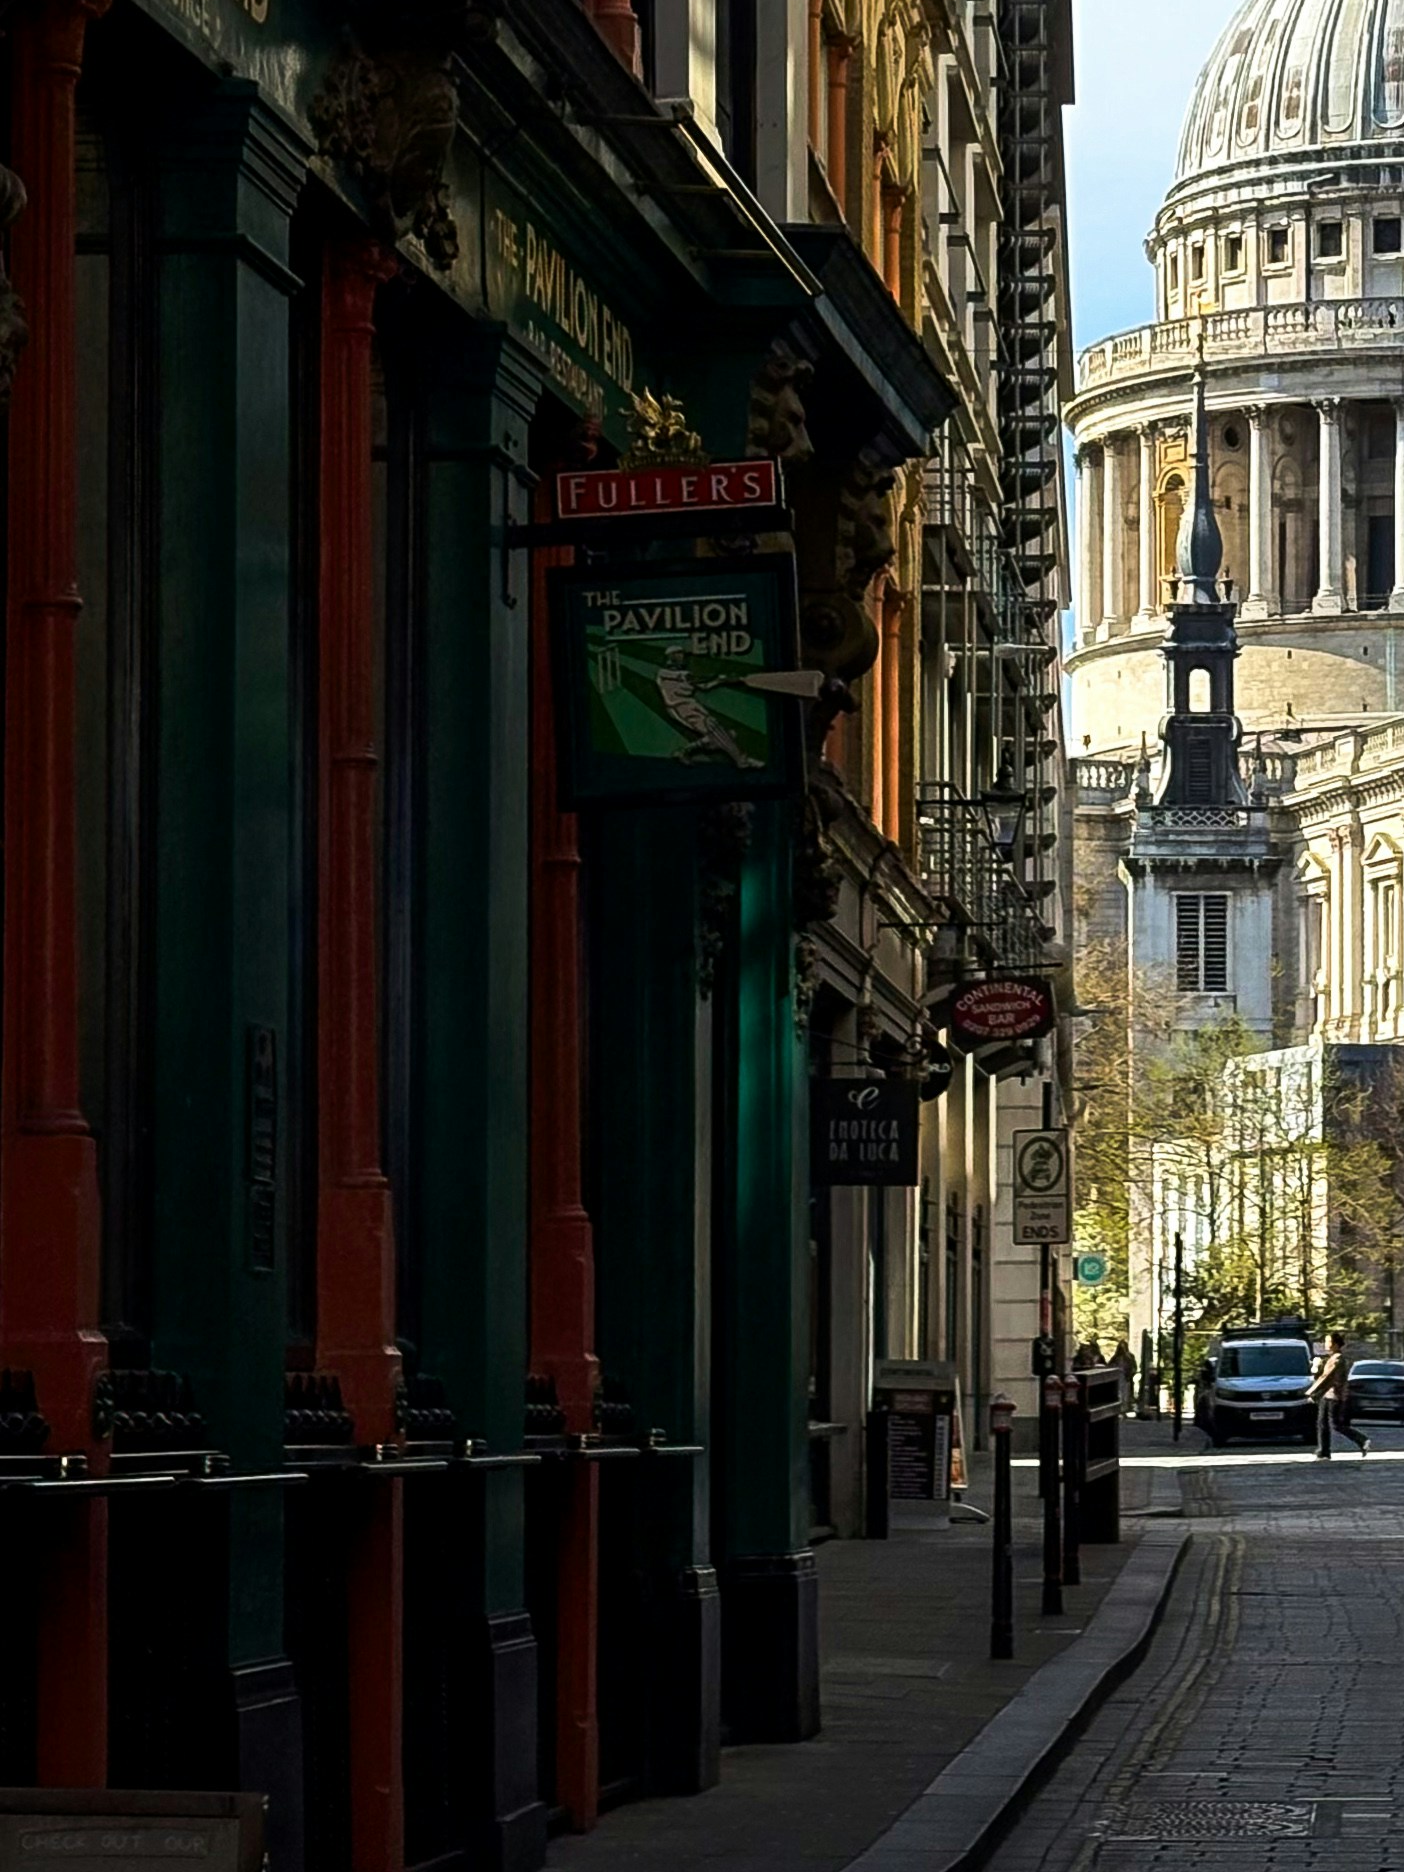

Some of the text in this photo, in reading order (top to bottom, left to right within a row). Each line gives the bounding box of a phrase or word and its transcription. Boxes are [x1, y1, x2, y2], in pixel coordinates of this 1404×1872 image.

[496, 207, 635, 395] THE PAVILION END
[569, 466, 762, 510] FULLER'S
[582, 590, 621, 608] THE
[602, 601, 748, 632] PAVILION
[691, 630, 751, 655] END
[955, 981, 1045, 1012] CONTINENTAL
[971, 1000, 1032, 1015] SANDWICH
[987, 1012, 1016, 1026] BAR
[828, 1141, 900, 1162] DA LUCA
[1022, 1225, 1060, 1239] ENDS
